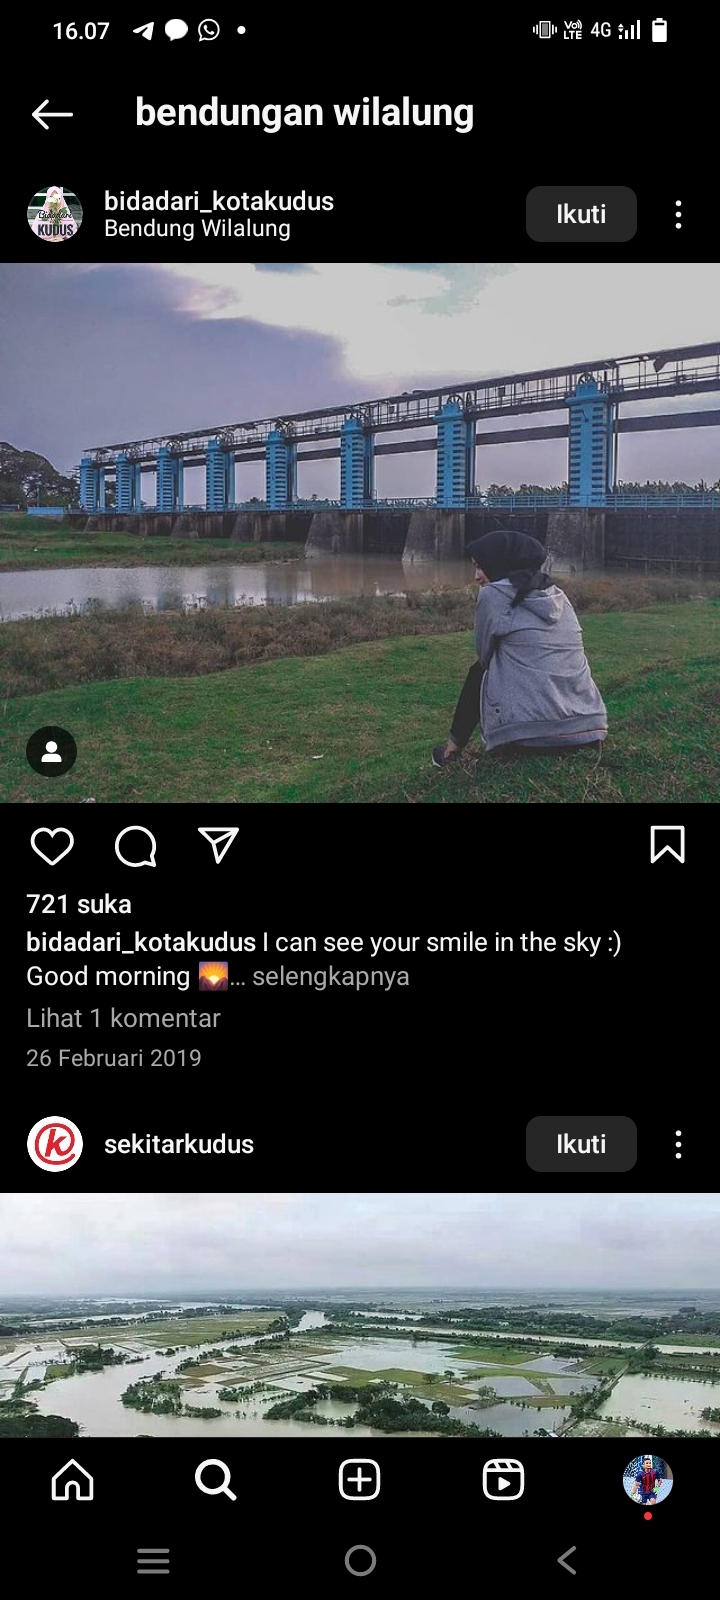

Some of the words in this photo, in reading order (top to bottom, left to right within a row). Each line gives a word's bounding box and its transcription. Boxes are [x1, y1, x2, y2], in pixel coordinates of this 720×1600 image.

[53, 21, 110, 40] 16.07
[563, 30, 582, 40] LTE
[590, 21, 612, 38] 4G
[136, 95, 324, 134] bendungan
[332, 95, 474, 134] wilalung
[104, 189, 335, 214] bidadari_kotakudus
[557, 202, 606, 225] Ikuti
[37, 224, 74, 236] KUDUS
[105, 217, 195, 242] Bendung
[201, 217, 291, 242] Wilalung
[26, 893, 67, 914] 721
[77, 892, 132, 915] suka
[26, 930, 257, 956] bidadari_kotakudus
[263, 931, 268, 952] I
[275, 936, 317, 953] can
[323, 936, 364, 953] see
[369, 936, 421, 958] your
[426, 930, 488, 953] smile
[495, 931, 514, 952] in
[519, 930, 557, 953] the
[563, 930, 602, 958] sky
[26, 964, 88, 987] Good
[95, 965, 190, 992] morning
[252, 964, 410, 992] selengkapnya
[27, 1006, 83, 1028] Lihat
[90, 1007, 99, 1028] 1
[111, 1006, 222, 1028] komentar
[26, 1048, 52, 1067] 26
[59, 1048, 143, 1067] Februari
[150, 1048, 202, 1067] 2019
[104, 1132, 255, 1155] sekitarkudus
[557, 1132, 606, 1155] Ikuti
